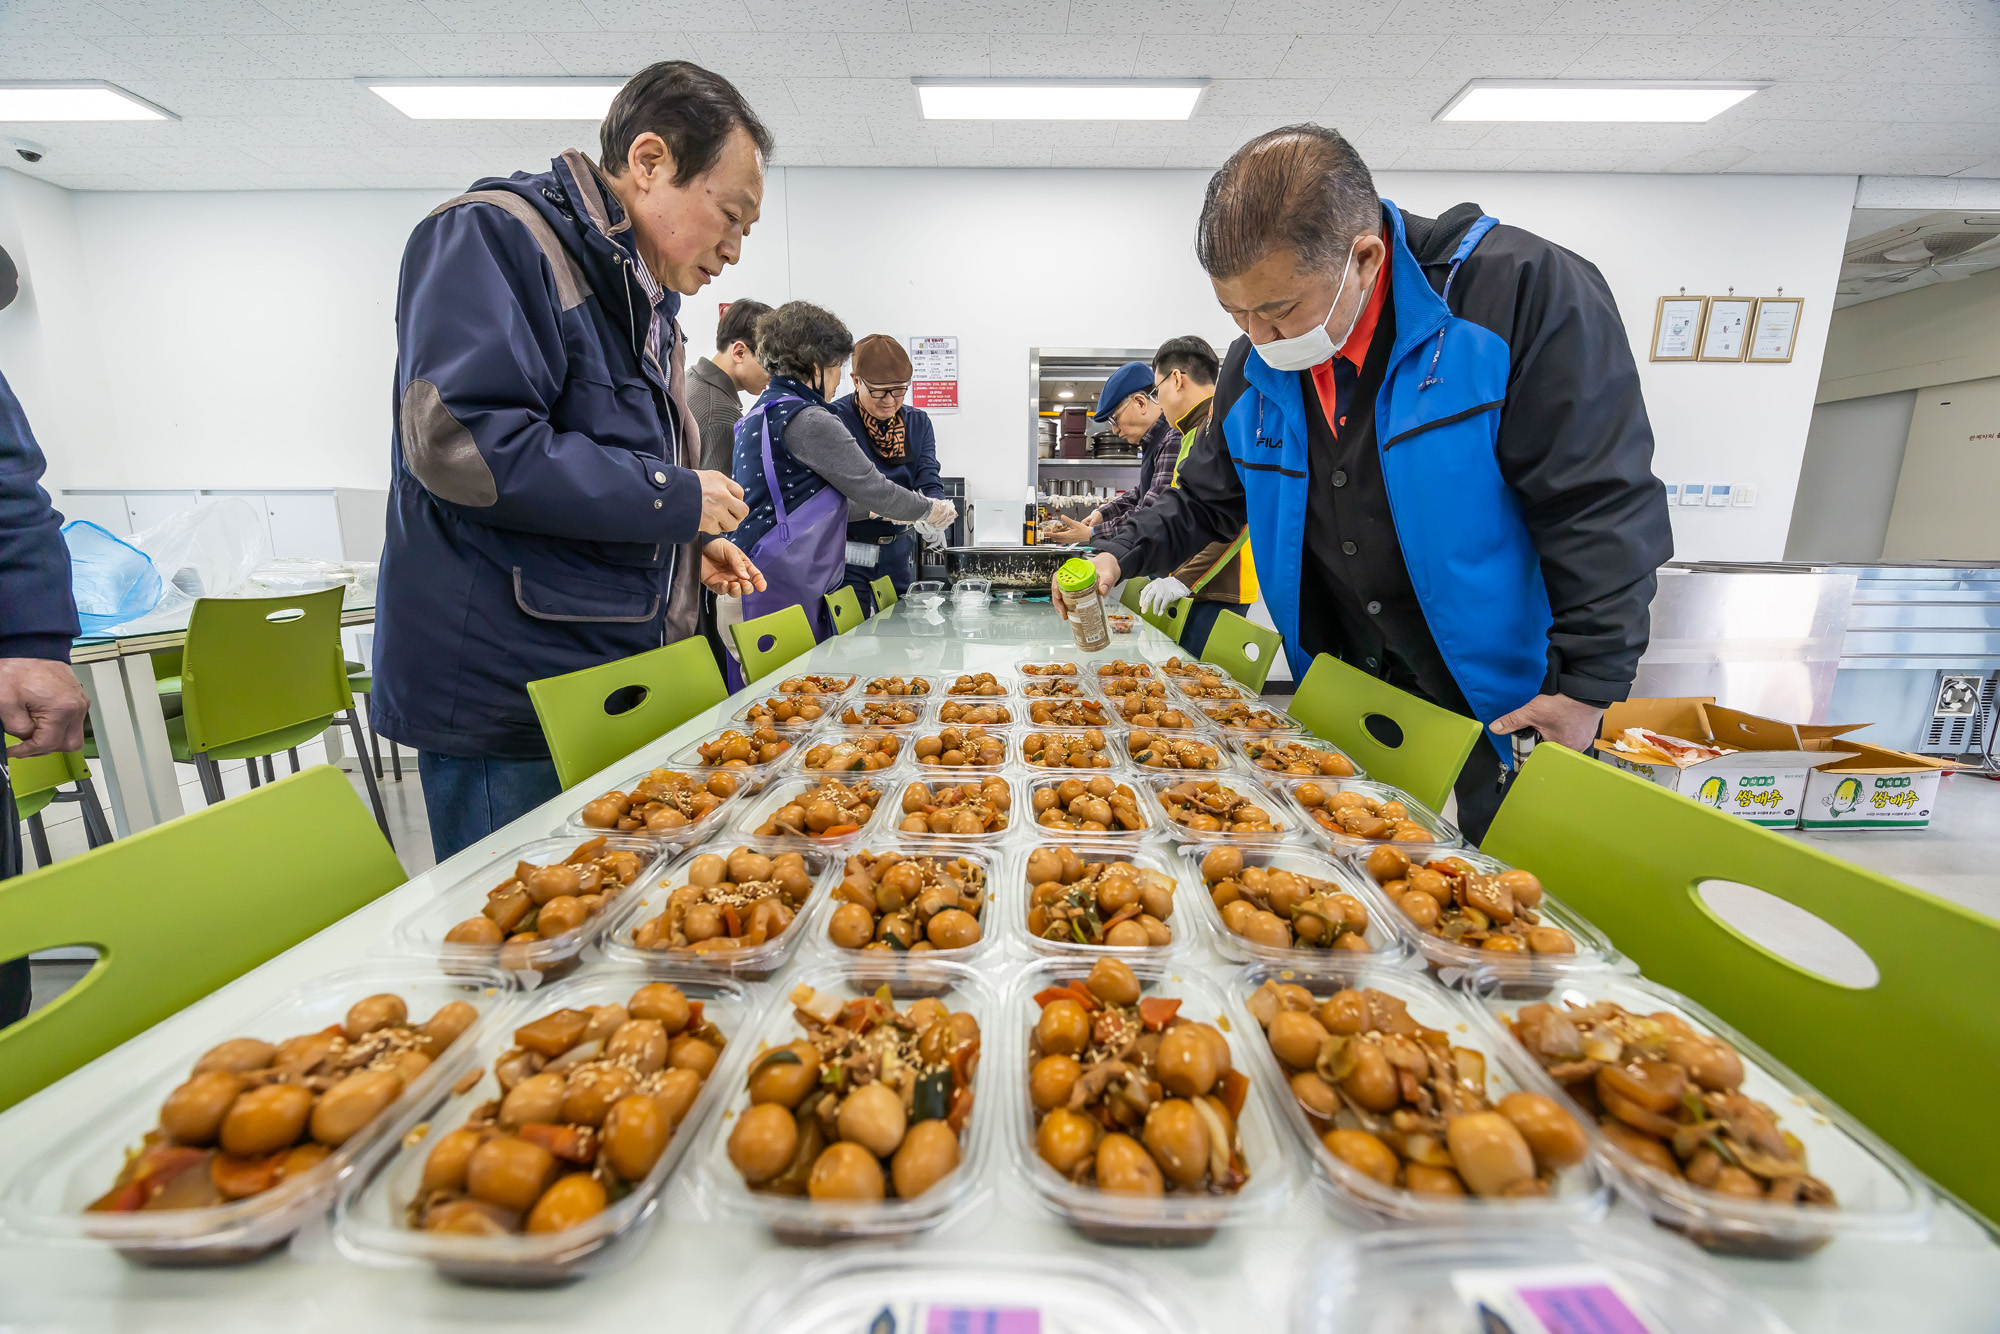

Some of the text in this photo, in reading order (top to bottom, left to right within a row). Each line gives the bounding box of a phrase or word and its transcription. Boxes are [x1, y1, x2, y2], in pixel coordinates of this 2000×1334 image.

[1256, 437, 1283, 448] FILA
[1734, 789, 1783, 809] 쌈배추
[1870, 790, 1919, 809] 쌈배추
